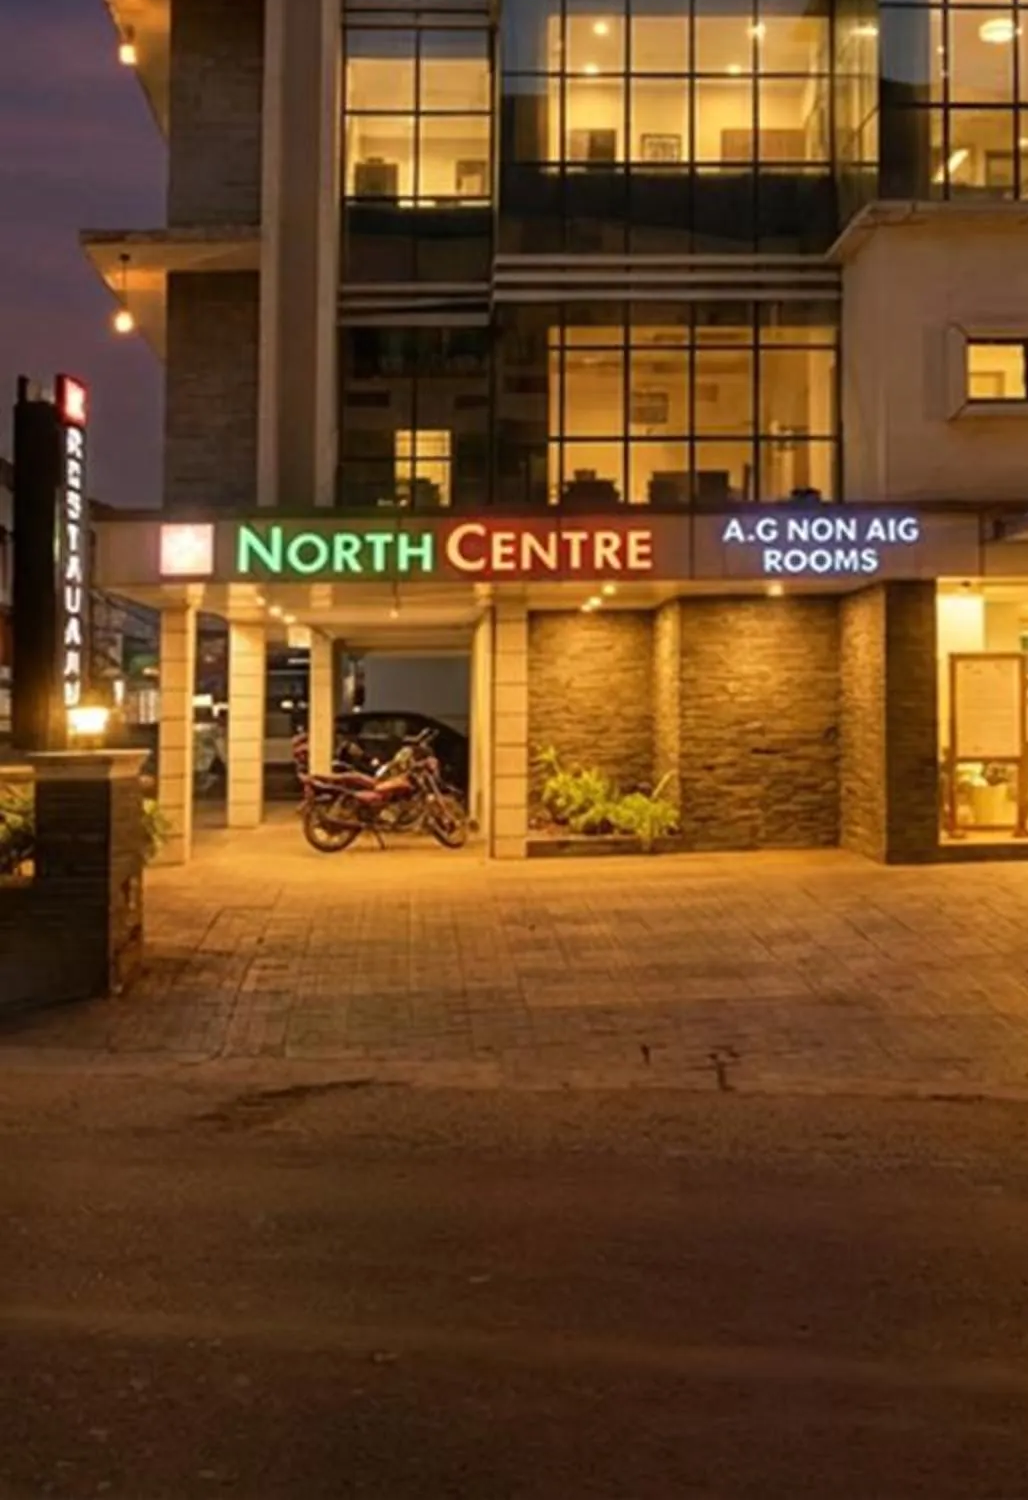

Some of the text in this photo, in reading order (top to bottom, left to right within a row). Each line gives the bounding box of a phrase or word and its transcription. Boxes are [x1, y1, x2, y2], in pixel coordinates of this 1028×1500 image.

[722, 517, 920, 542] A.G NON AIG
[237, 522, 652, 574] NORTH CENTRE
[763, 548, 879, 573] ROOMS
